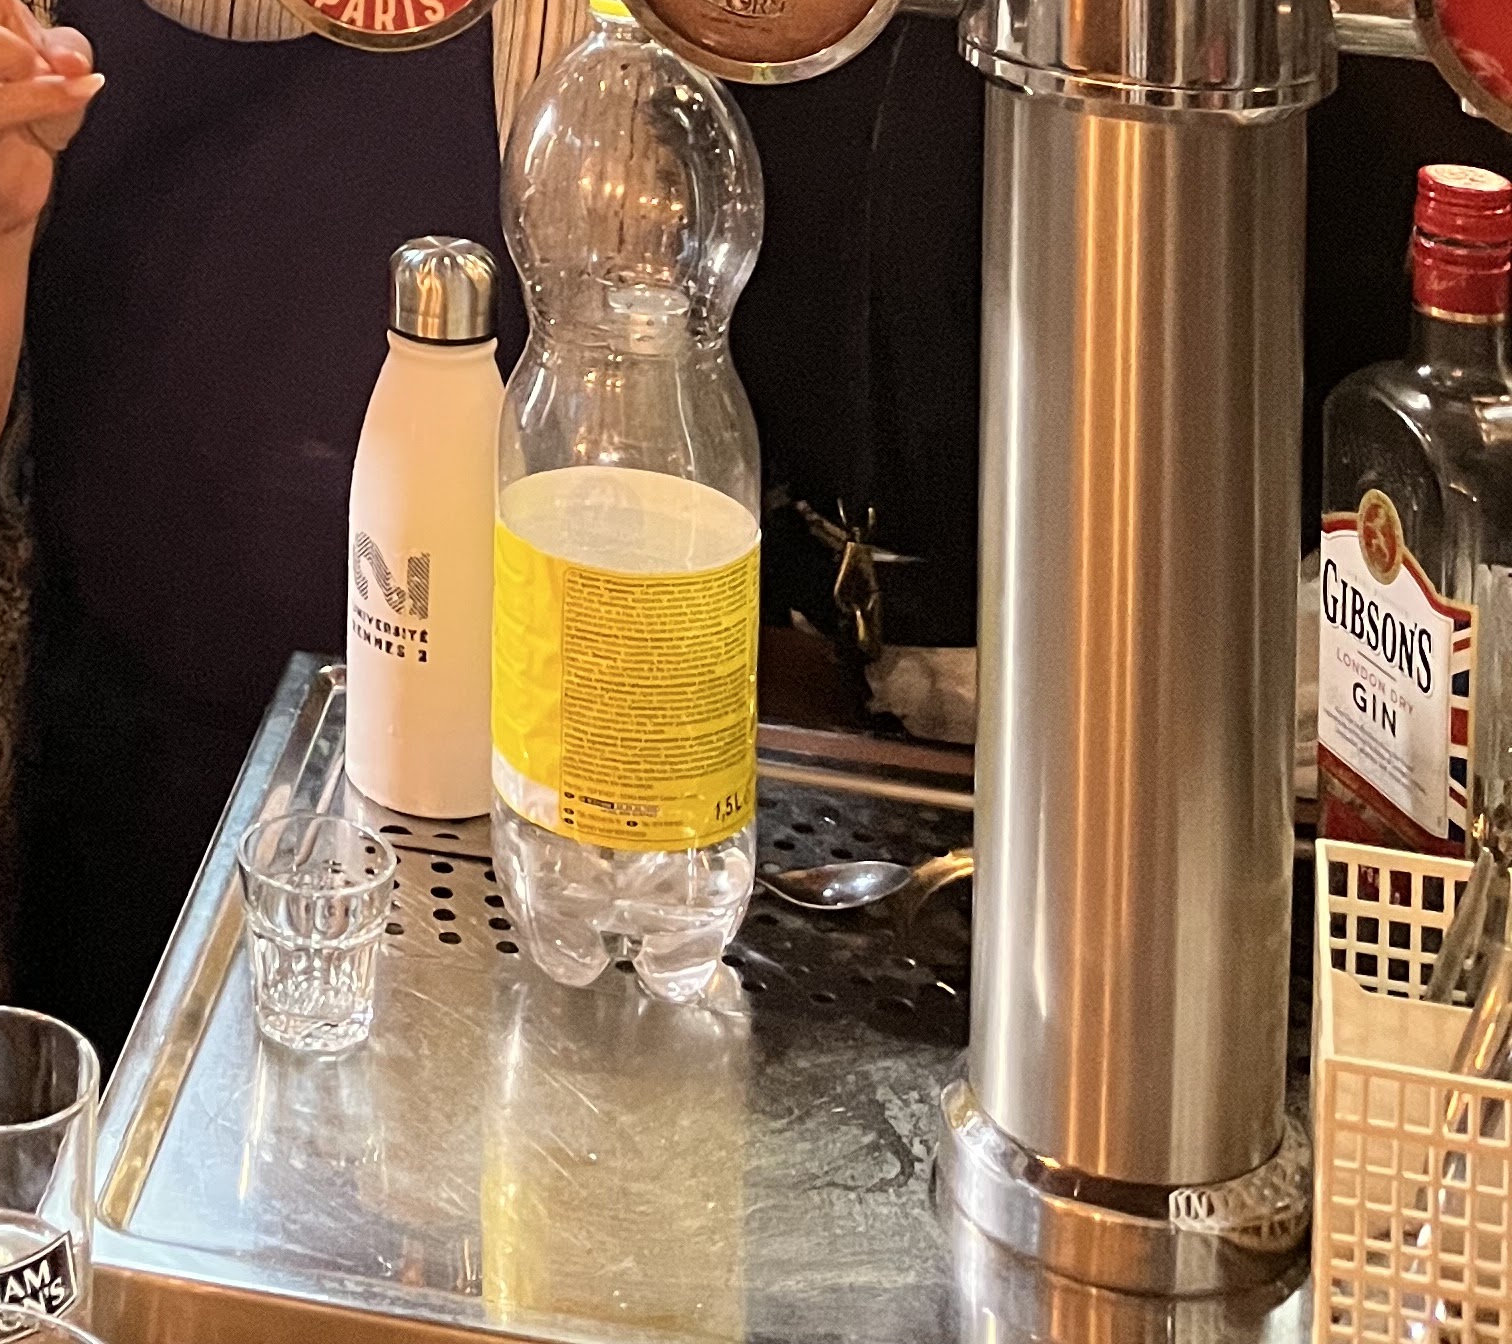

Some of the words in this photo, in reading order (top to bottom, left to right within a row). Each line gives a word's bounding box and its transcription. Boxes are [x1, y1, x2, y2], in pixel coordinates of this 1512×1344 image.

[353, 605, 429, 644] UNIVERSITÉ
[1322, 559, 1433, 694] GIBSON'S
[418, 649, 428, 663] 2
[1336, 647, 1386, 694] LONDON
[1390, 688, 1414, 714] DRY
[1353, 682, 1396, 738] GIN
